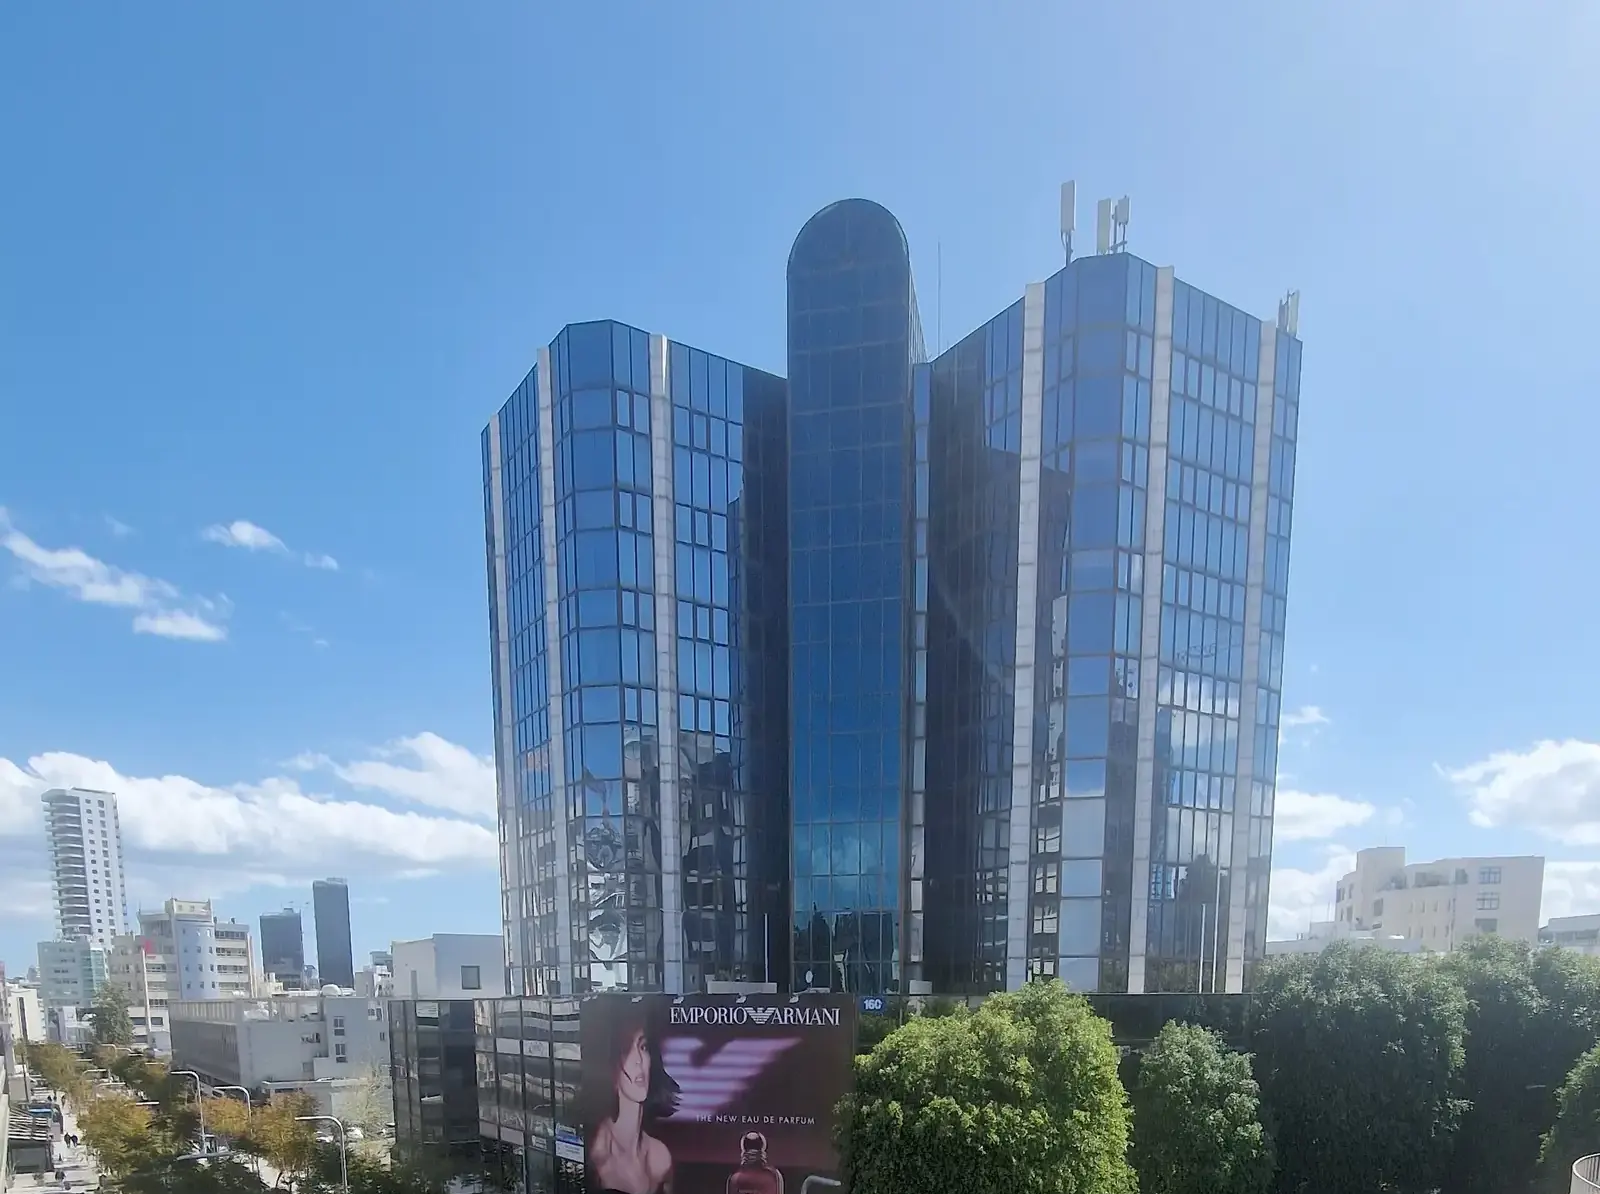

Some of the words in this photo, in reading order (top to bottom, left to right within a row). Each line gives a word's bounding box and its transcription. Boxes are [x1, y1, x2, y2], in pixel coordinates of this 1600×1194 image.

[863, 999, 882, 1010] 160
[670, 1007, 748, 1025] EMPORIO
[770, 1008, 841, 1026] ARMANI
[696, 1114, 713, 1123] THE
[716, 1115, 738, 1123] NEW
[741, 1116, 760, 1124] EAU
[763, 1116, 775, 1125] DE
[778, 1117, 816, 1126] PARFUM
